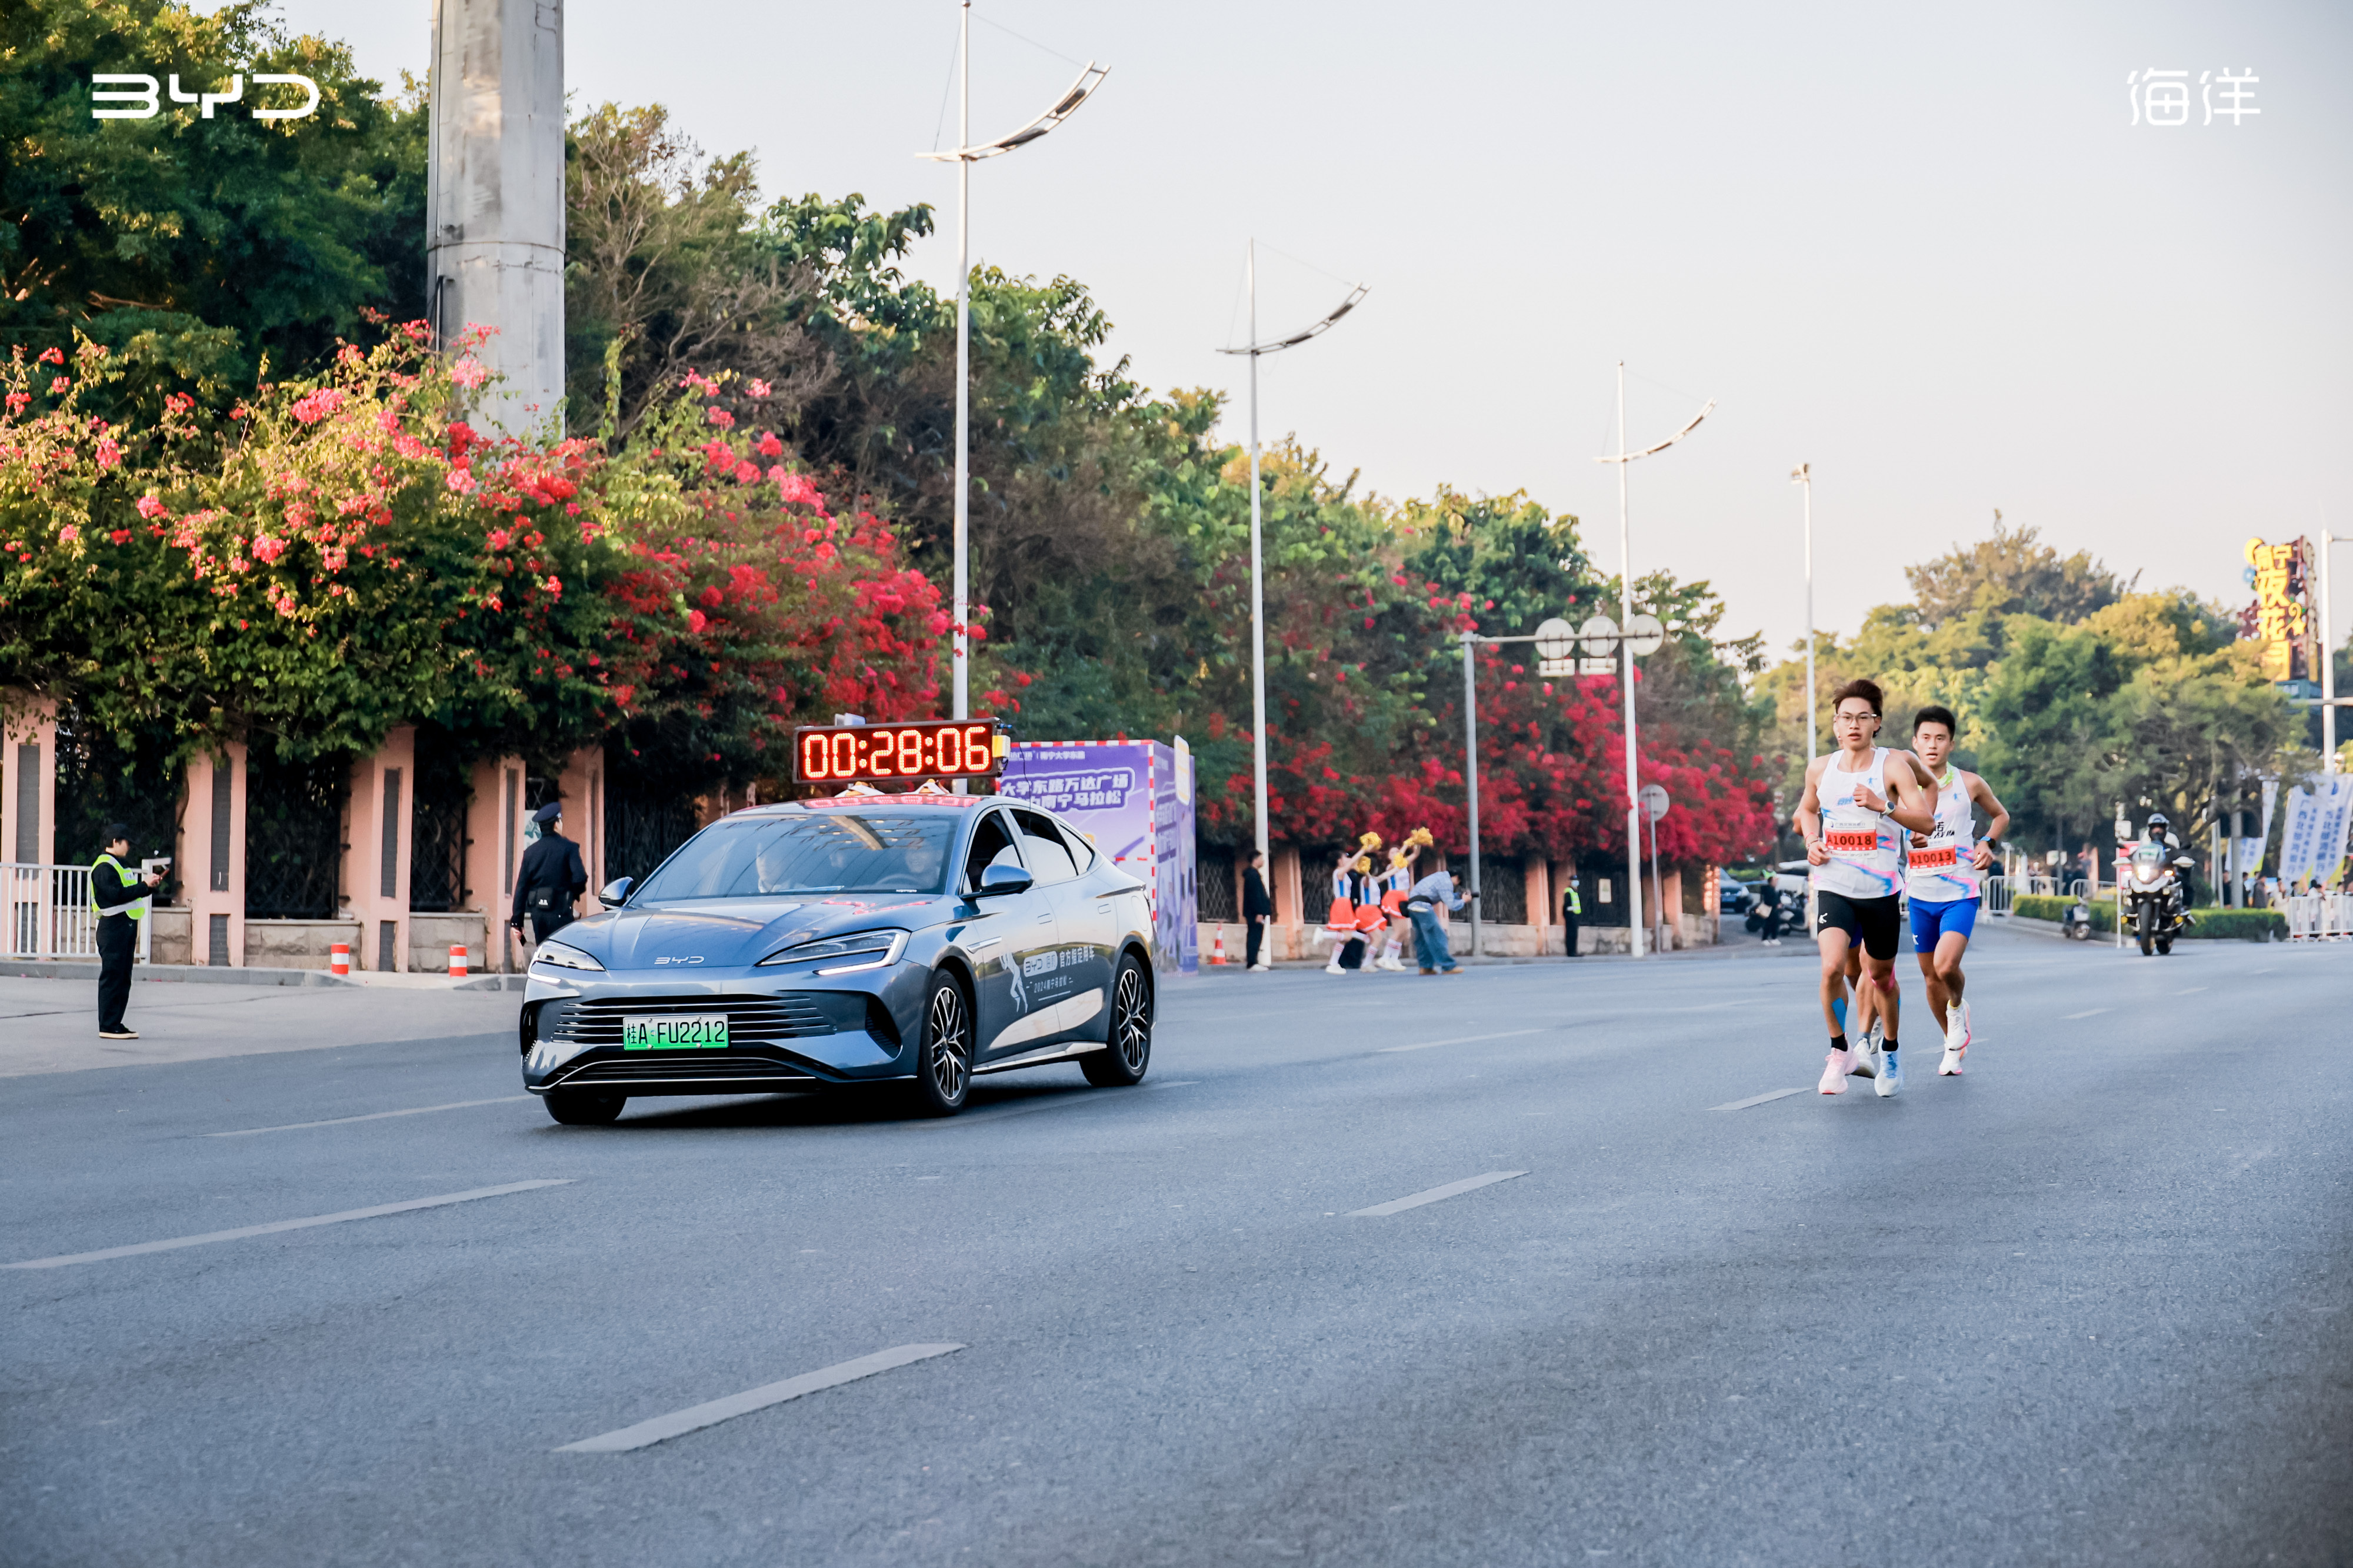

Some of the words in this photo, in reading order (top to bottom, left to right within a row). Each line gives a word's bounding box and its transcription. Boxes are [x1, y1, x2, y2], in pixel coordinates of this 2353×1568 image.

[804, 726, 989, 779] 00:28:06
[1001, 773, 1129, 796] 大学东路万达广场
[1827, 834, 1872, 846] A10018
[1911, 851, 1951, 864] A10013
[654, 956, 705, 965] BYD
[1025, 959, 1042, 973] BYD
